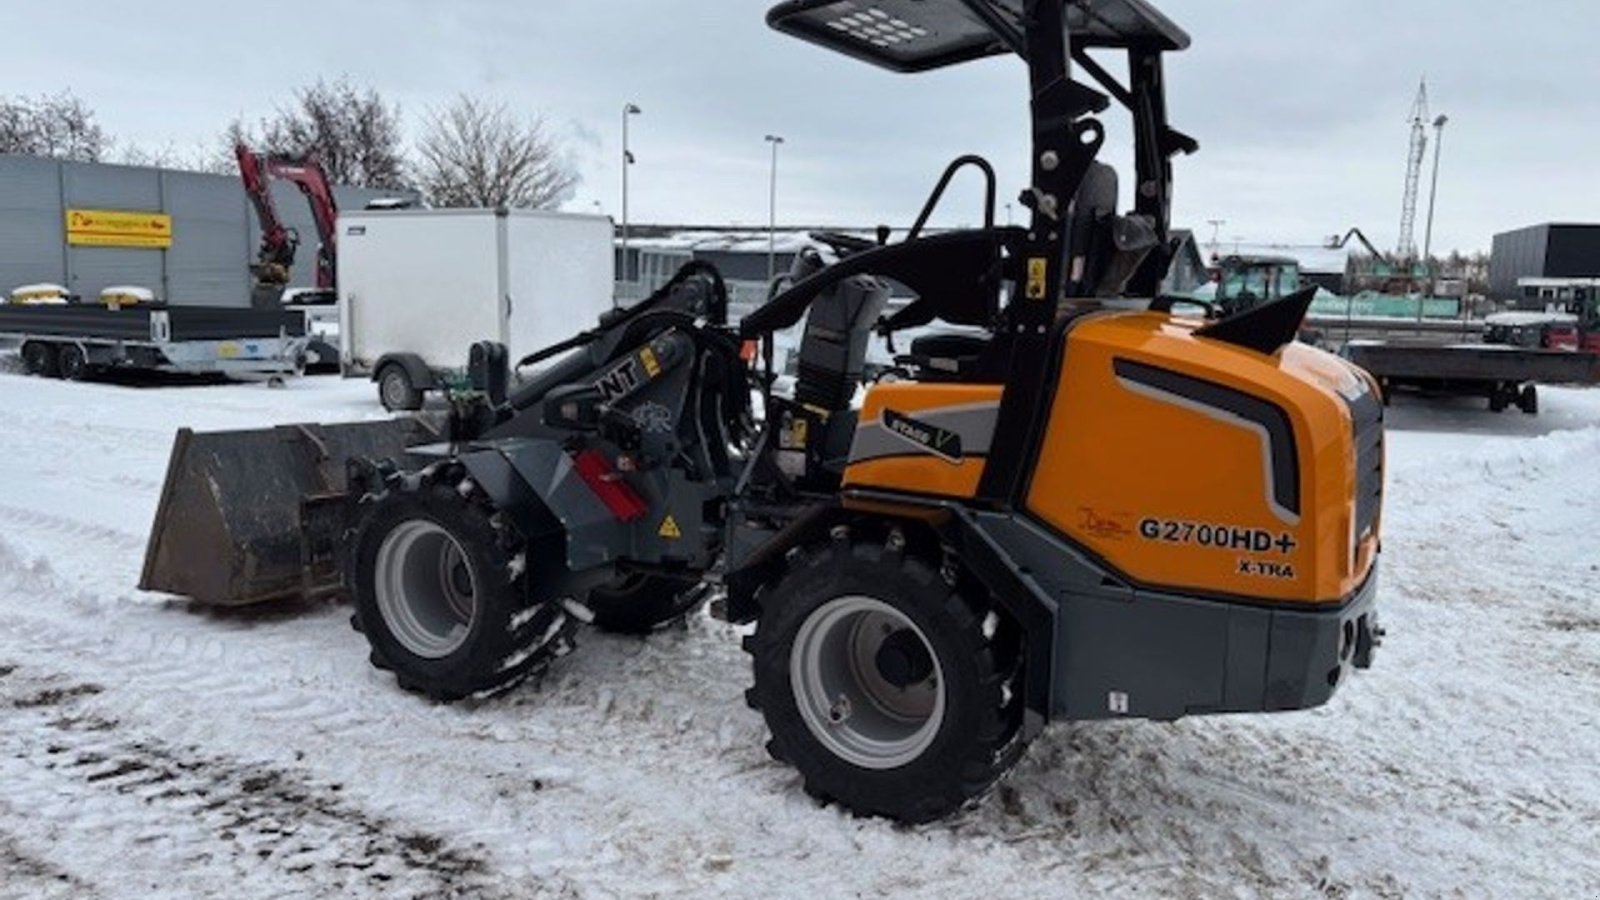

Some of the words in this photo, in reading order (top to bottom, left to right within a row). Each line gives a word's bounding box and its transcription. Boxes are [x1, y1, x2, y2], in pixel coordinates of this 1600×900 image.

[593, 356, 639, 405] NT
[935, 429, 954, 448] V
[1140, 519, 1296, 554] G2700HD+
[1238, 559, 1294, 577] X-TRA
